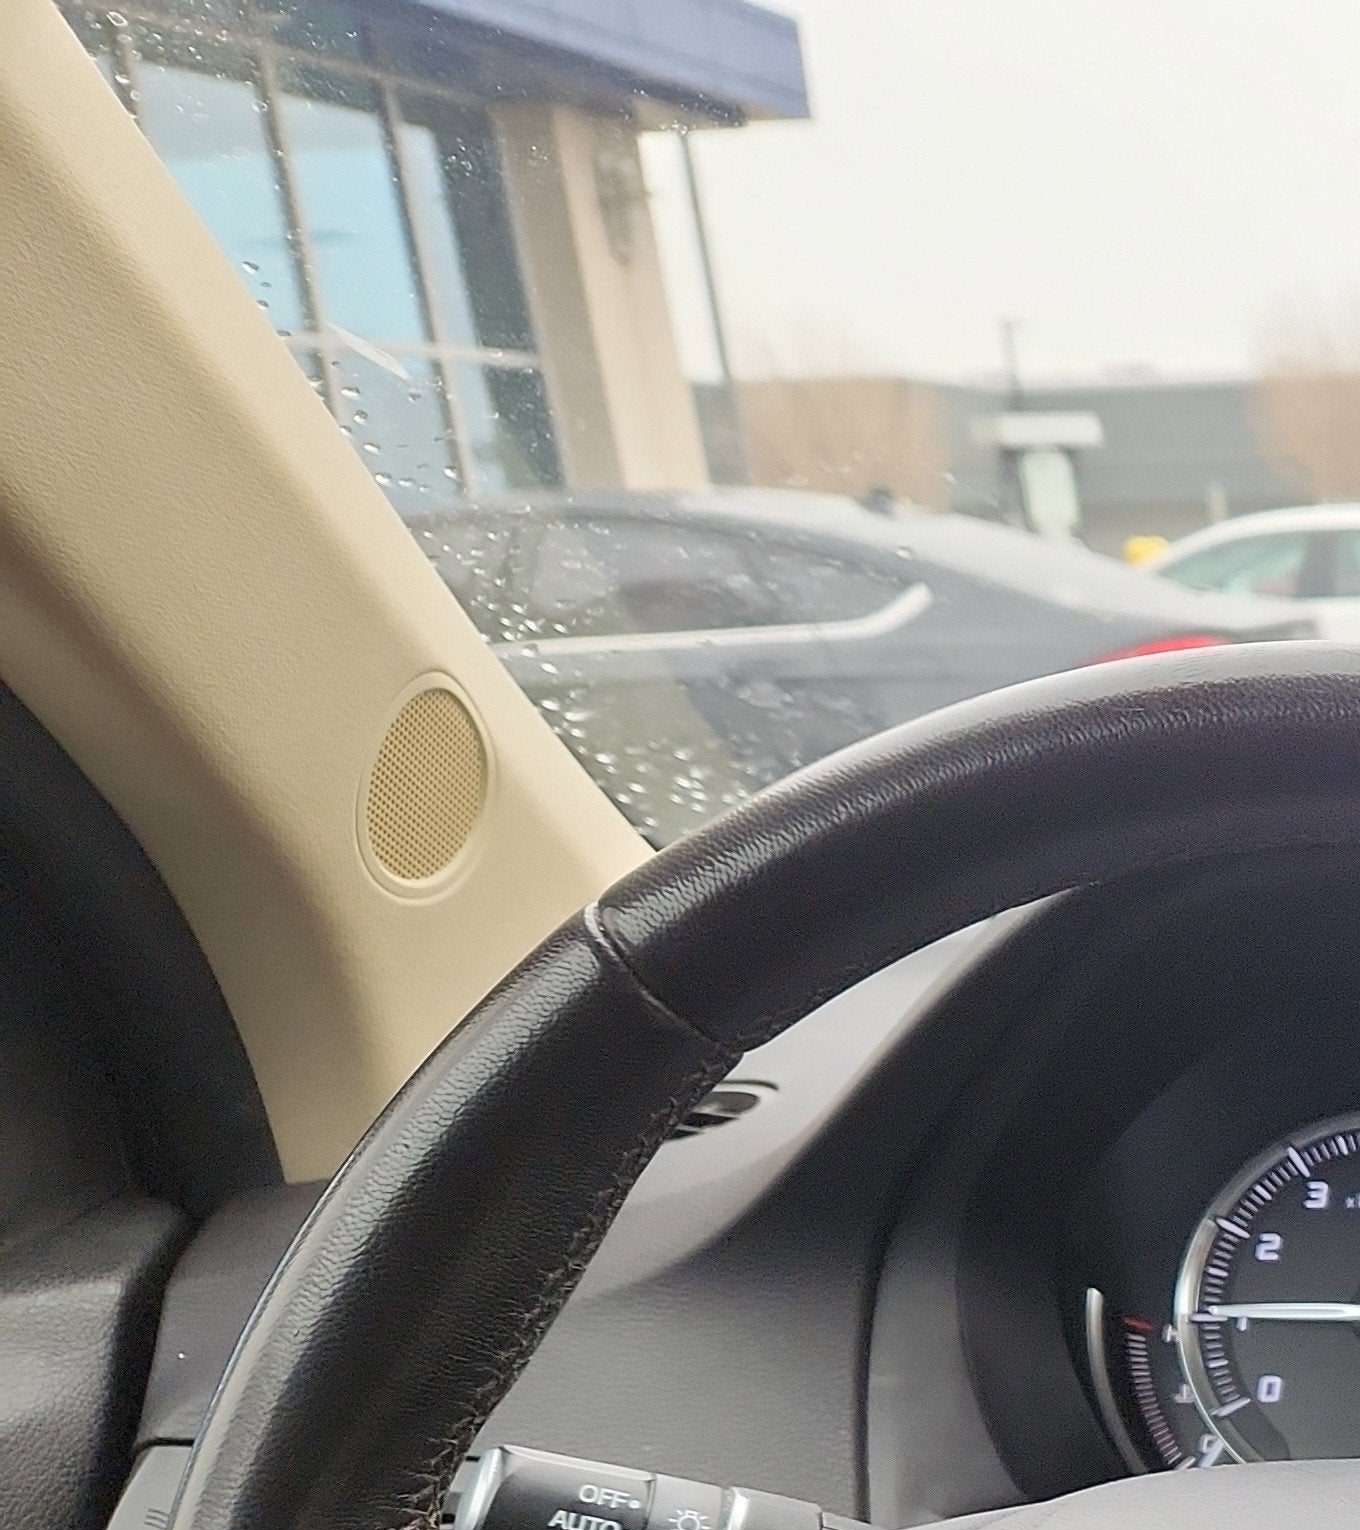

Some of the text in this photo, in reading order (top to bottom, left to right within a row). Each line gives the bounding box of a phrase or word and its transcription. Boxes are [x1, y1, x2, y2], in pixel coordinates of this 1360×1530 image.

[1303, 1181, 1329, 1209] 3
[1256, 1233, 1281, 1260] 2
[1256, 1375, 1283, 1403] 0
[579, 1484, 627, 1510] OFF
